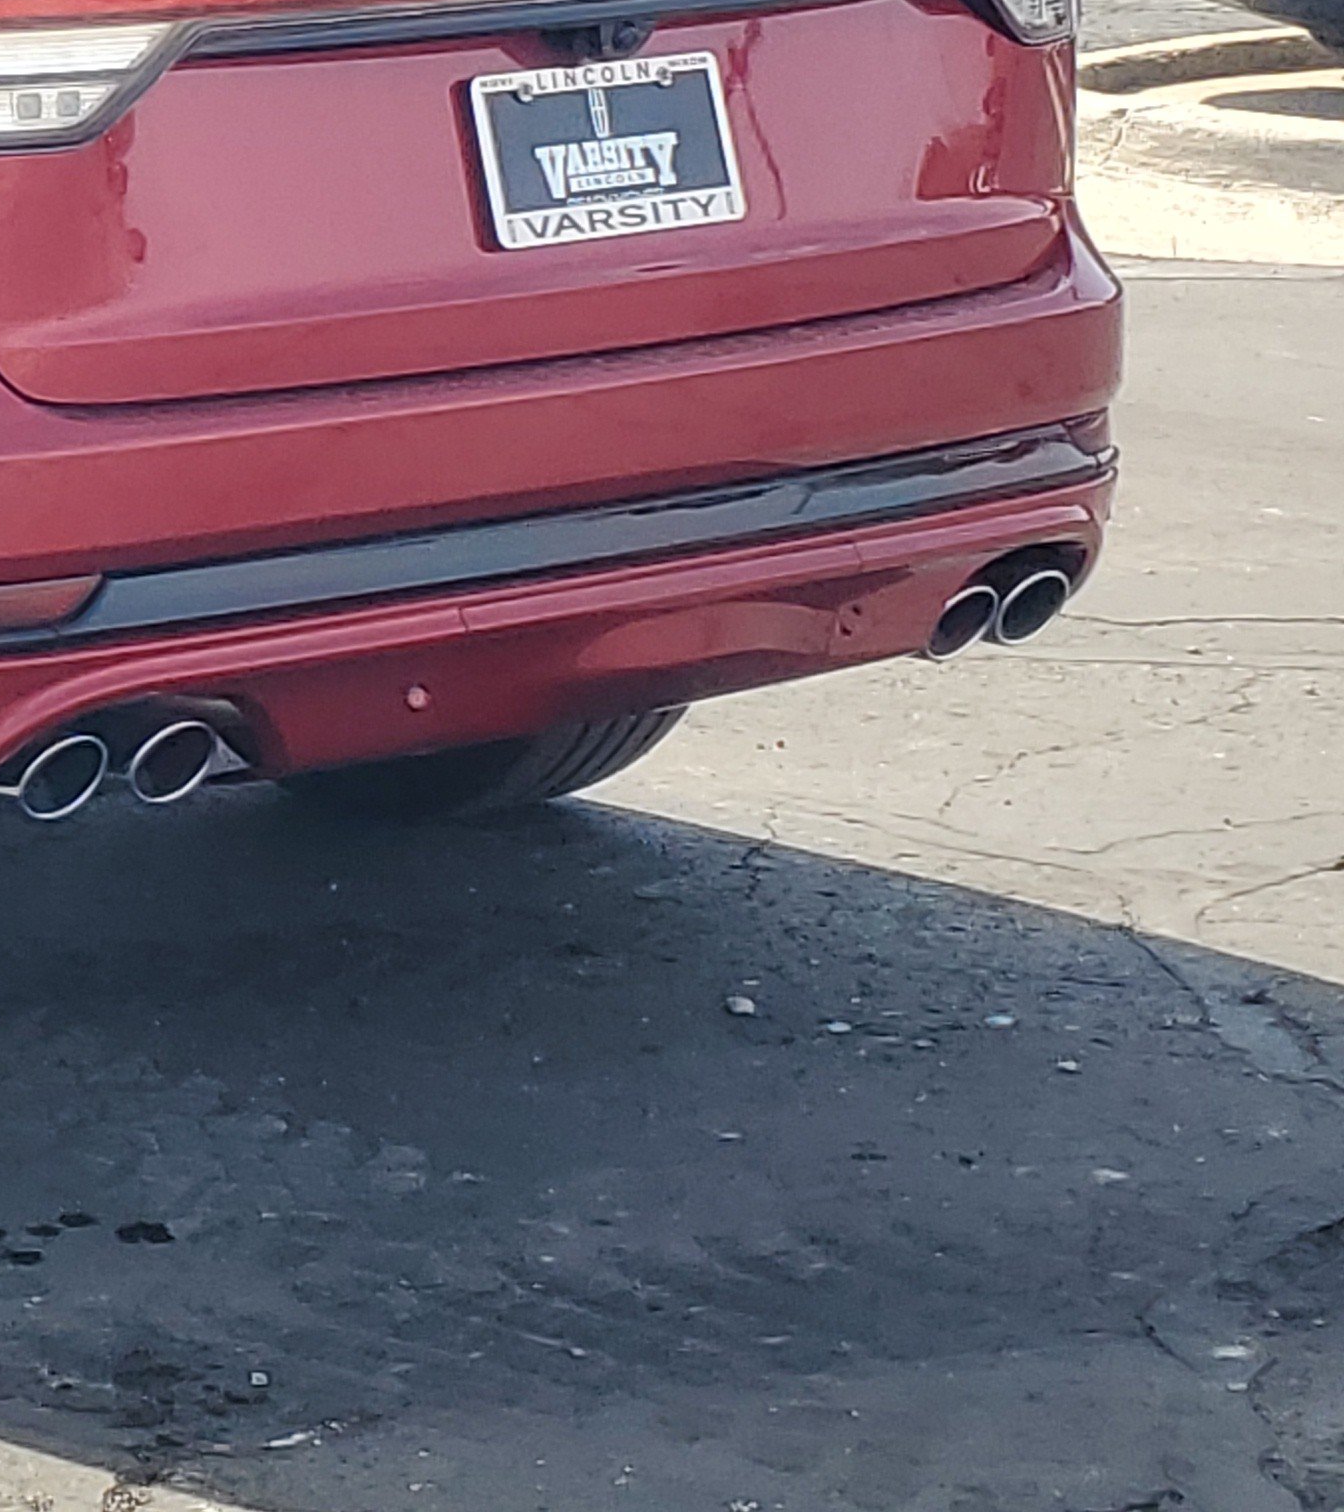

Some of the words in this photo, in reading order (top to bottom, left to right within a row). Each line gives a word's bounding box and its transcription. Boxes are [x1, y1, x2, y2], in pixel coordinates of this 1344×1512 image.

[535, 62, 651, 91] LINCOLN
[534, 131, 679, 200] VARSITY
[576, 172, 647, 189] LINCOLN
[523, 194, 717, 240] VARSITY
